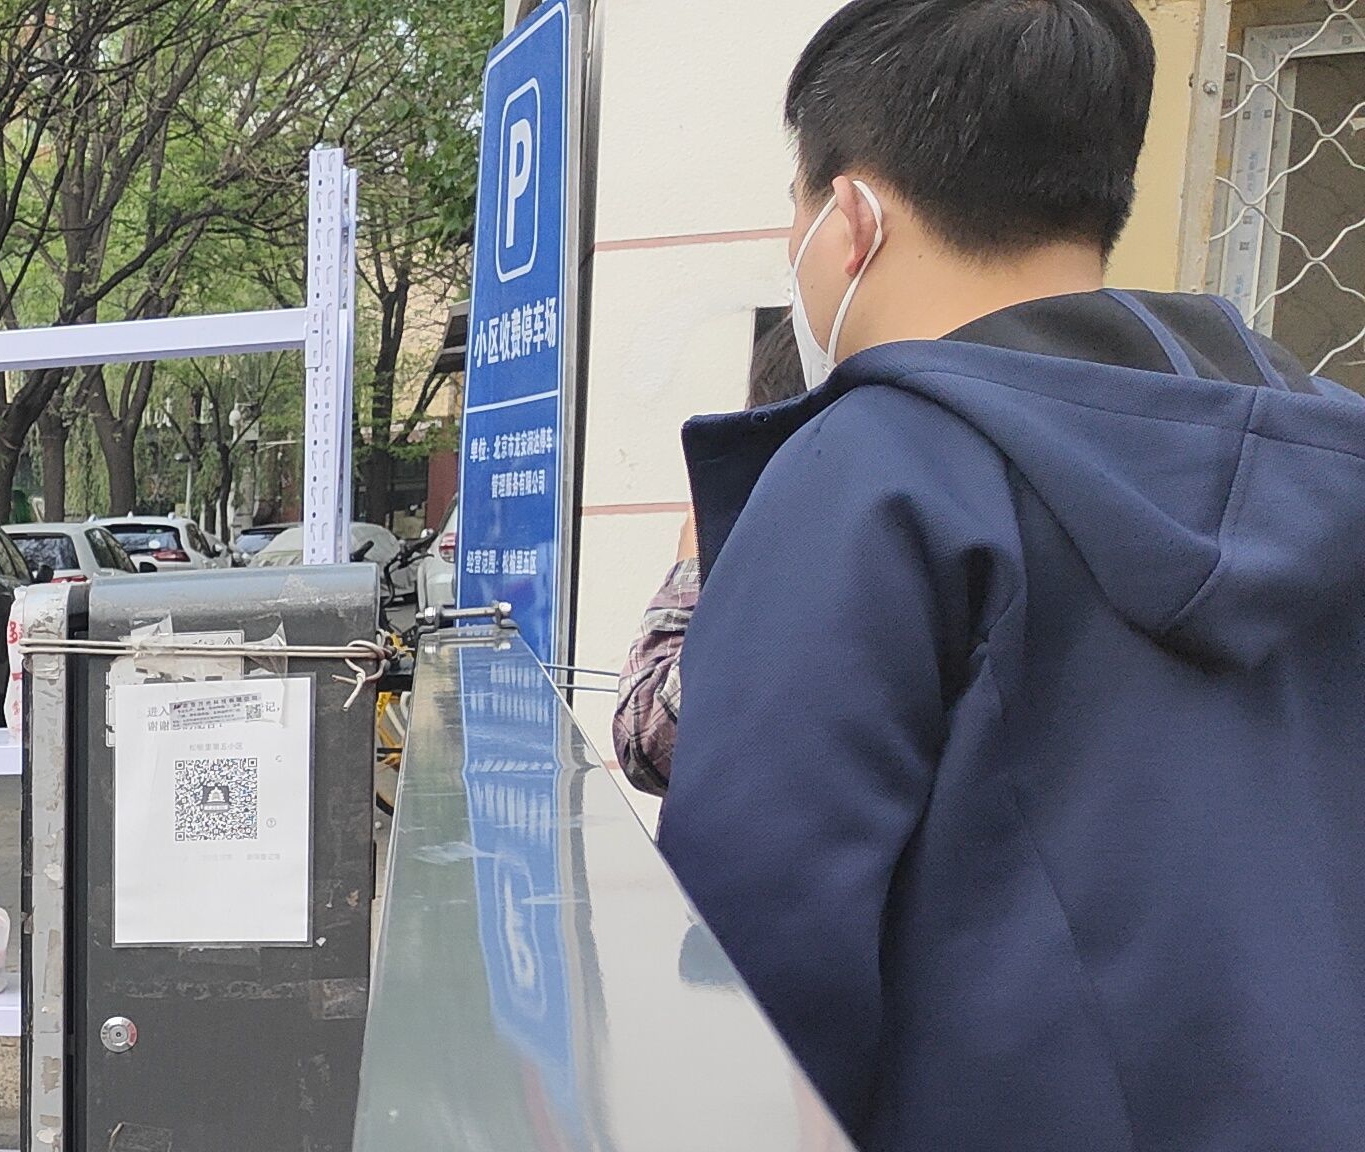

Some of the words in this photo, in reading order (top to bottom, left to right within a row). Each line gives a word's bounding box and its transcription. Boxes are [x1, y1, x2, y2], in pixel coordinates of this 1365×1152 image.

[505, 119, 532, 247] P
[474, 297, 556, 367] 小区收费停车场
